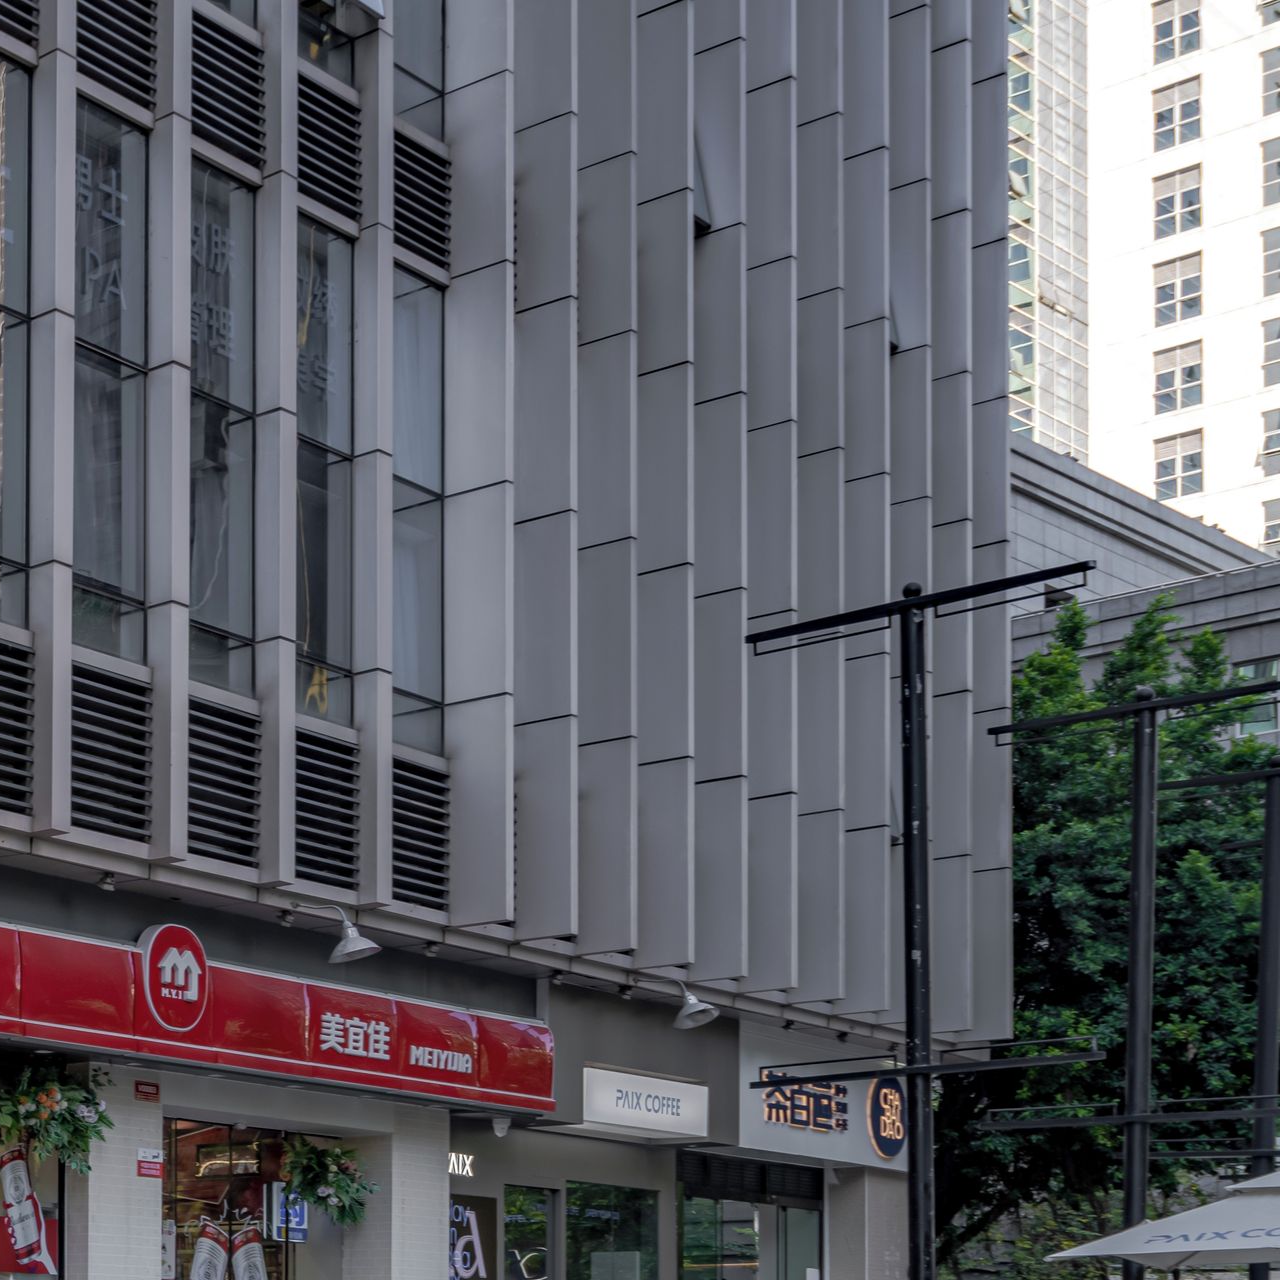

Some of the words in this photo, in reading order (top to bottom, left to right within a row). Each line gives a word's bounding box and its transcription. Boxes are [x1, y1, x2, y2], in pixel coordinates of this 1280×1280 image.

[319, 1011, 391, 1061] 美宜佳
[408, 1044, 473, 1074] MEIYIJIA
[615, 1089, 642, 1111] PAIX
[644, 1093, 681, 1116] COFFEE
[1143, 1230, 1236, 1244] PAIX
